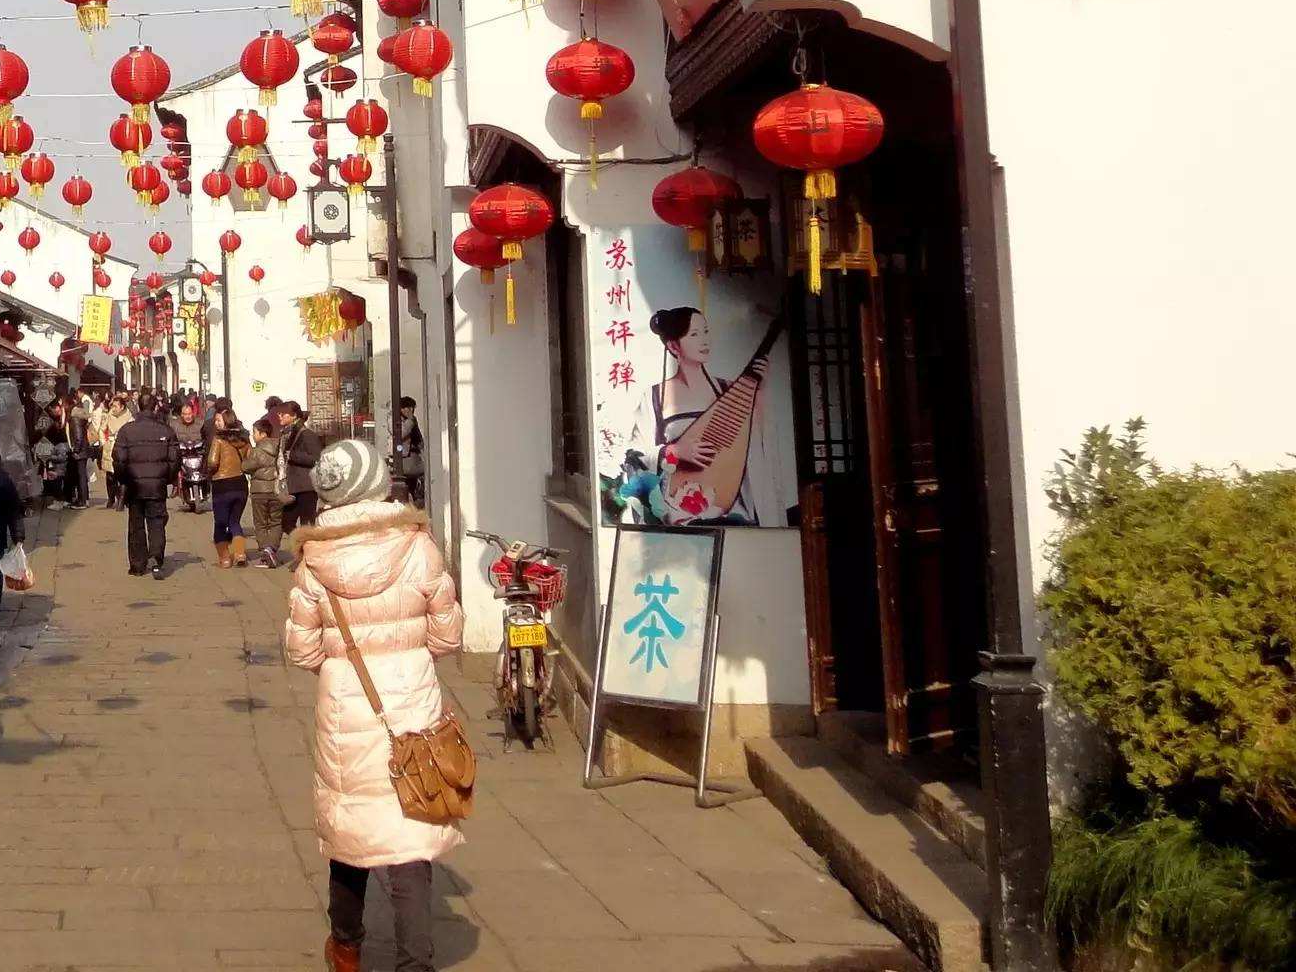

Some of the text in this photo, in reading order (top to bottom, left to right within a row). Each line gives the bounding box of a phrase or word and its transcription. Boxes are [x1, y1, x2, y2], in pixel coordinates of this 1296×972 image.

[605, 238, 635, 392] 苏州评弹
[623, 573, 686, 673] 茶
